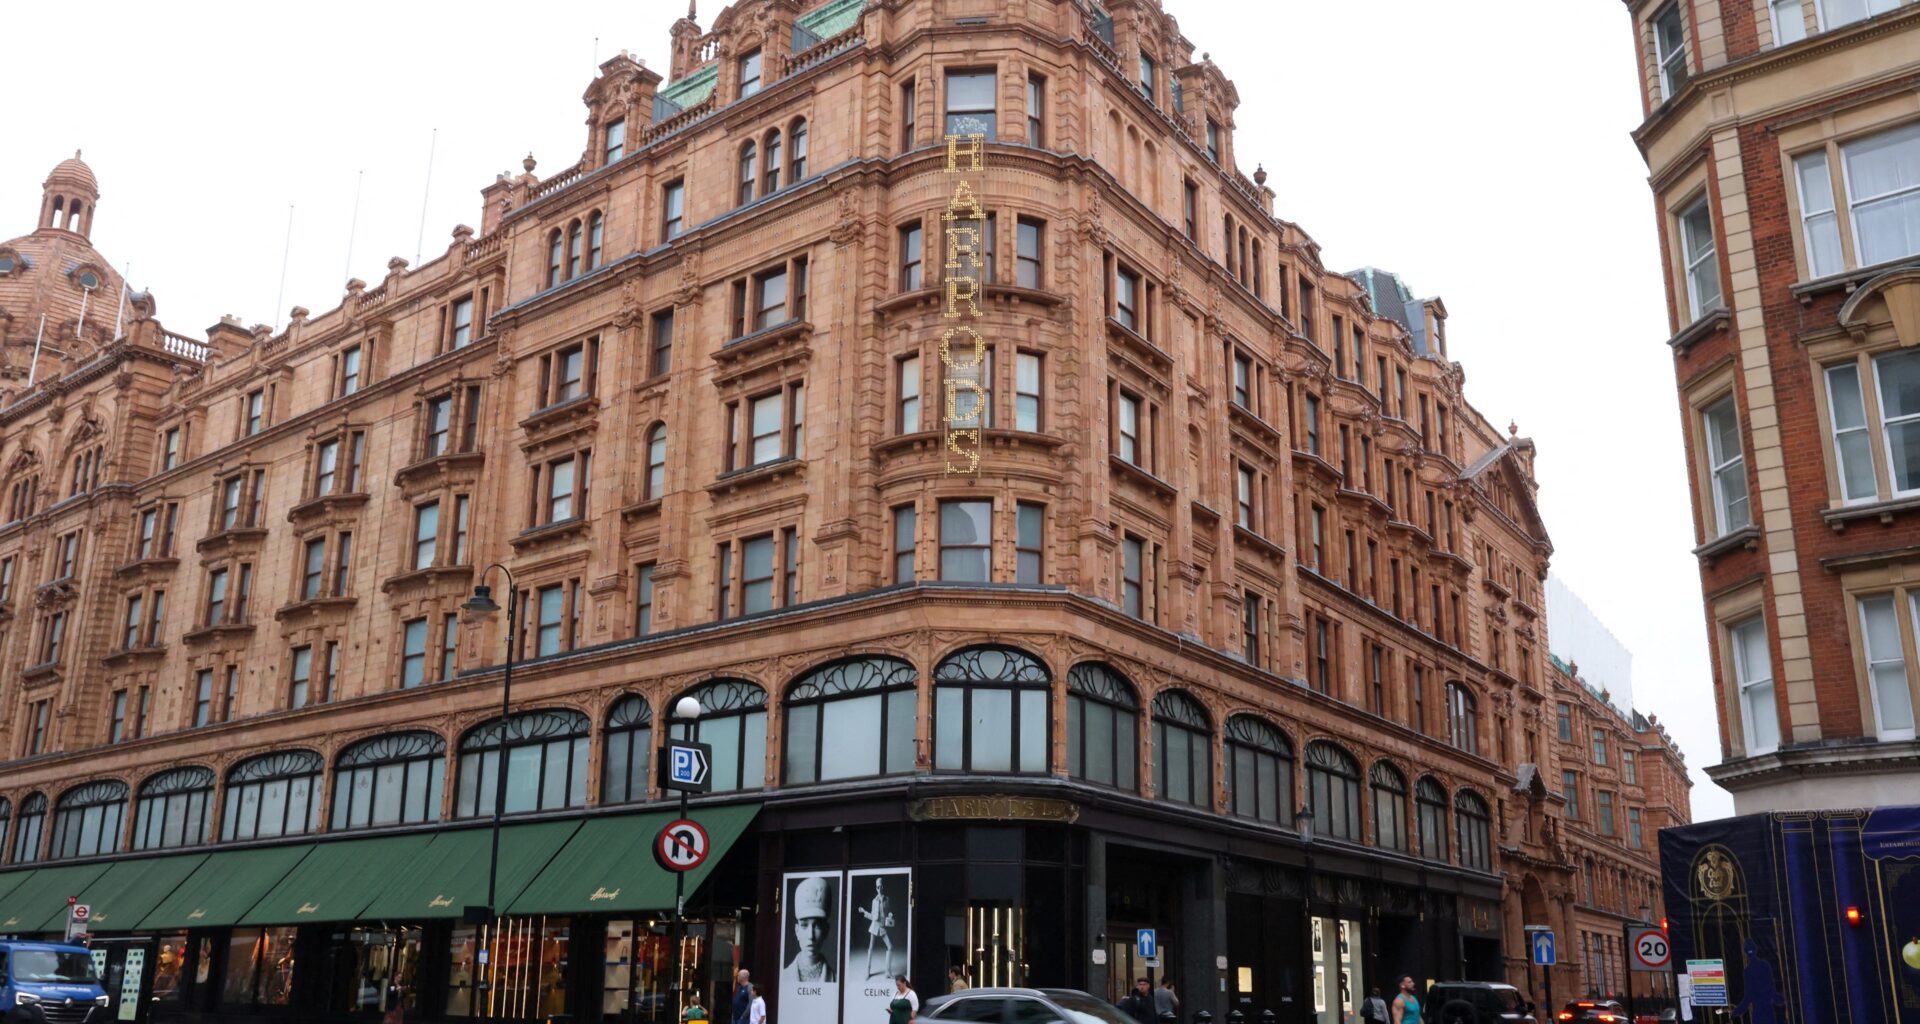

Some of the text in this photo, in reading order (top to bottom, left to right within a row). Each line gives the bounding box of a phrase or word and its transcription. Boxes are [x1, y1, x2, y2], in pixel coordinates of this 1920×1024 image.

[939, 133, 986, 474] HARRODS
[674, 751, 689, 777] P
[680, 769, 690, 777] 200
[1641, 941, 1667, 956] 20
[797, 987, 821, 996] CELINE
[864, 988, 890, 997] CELINE
